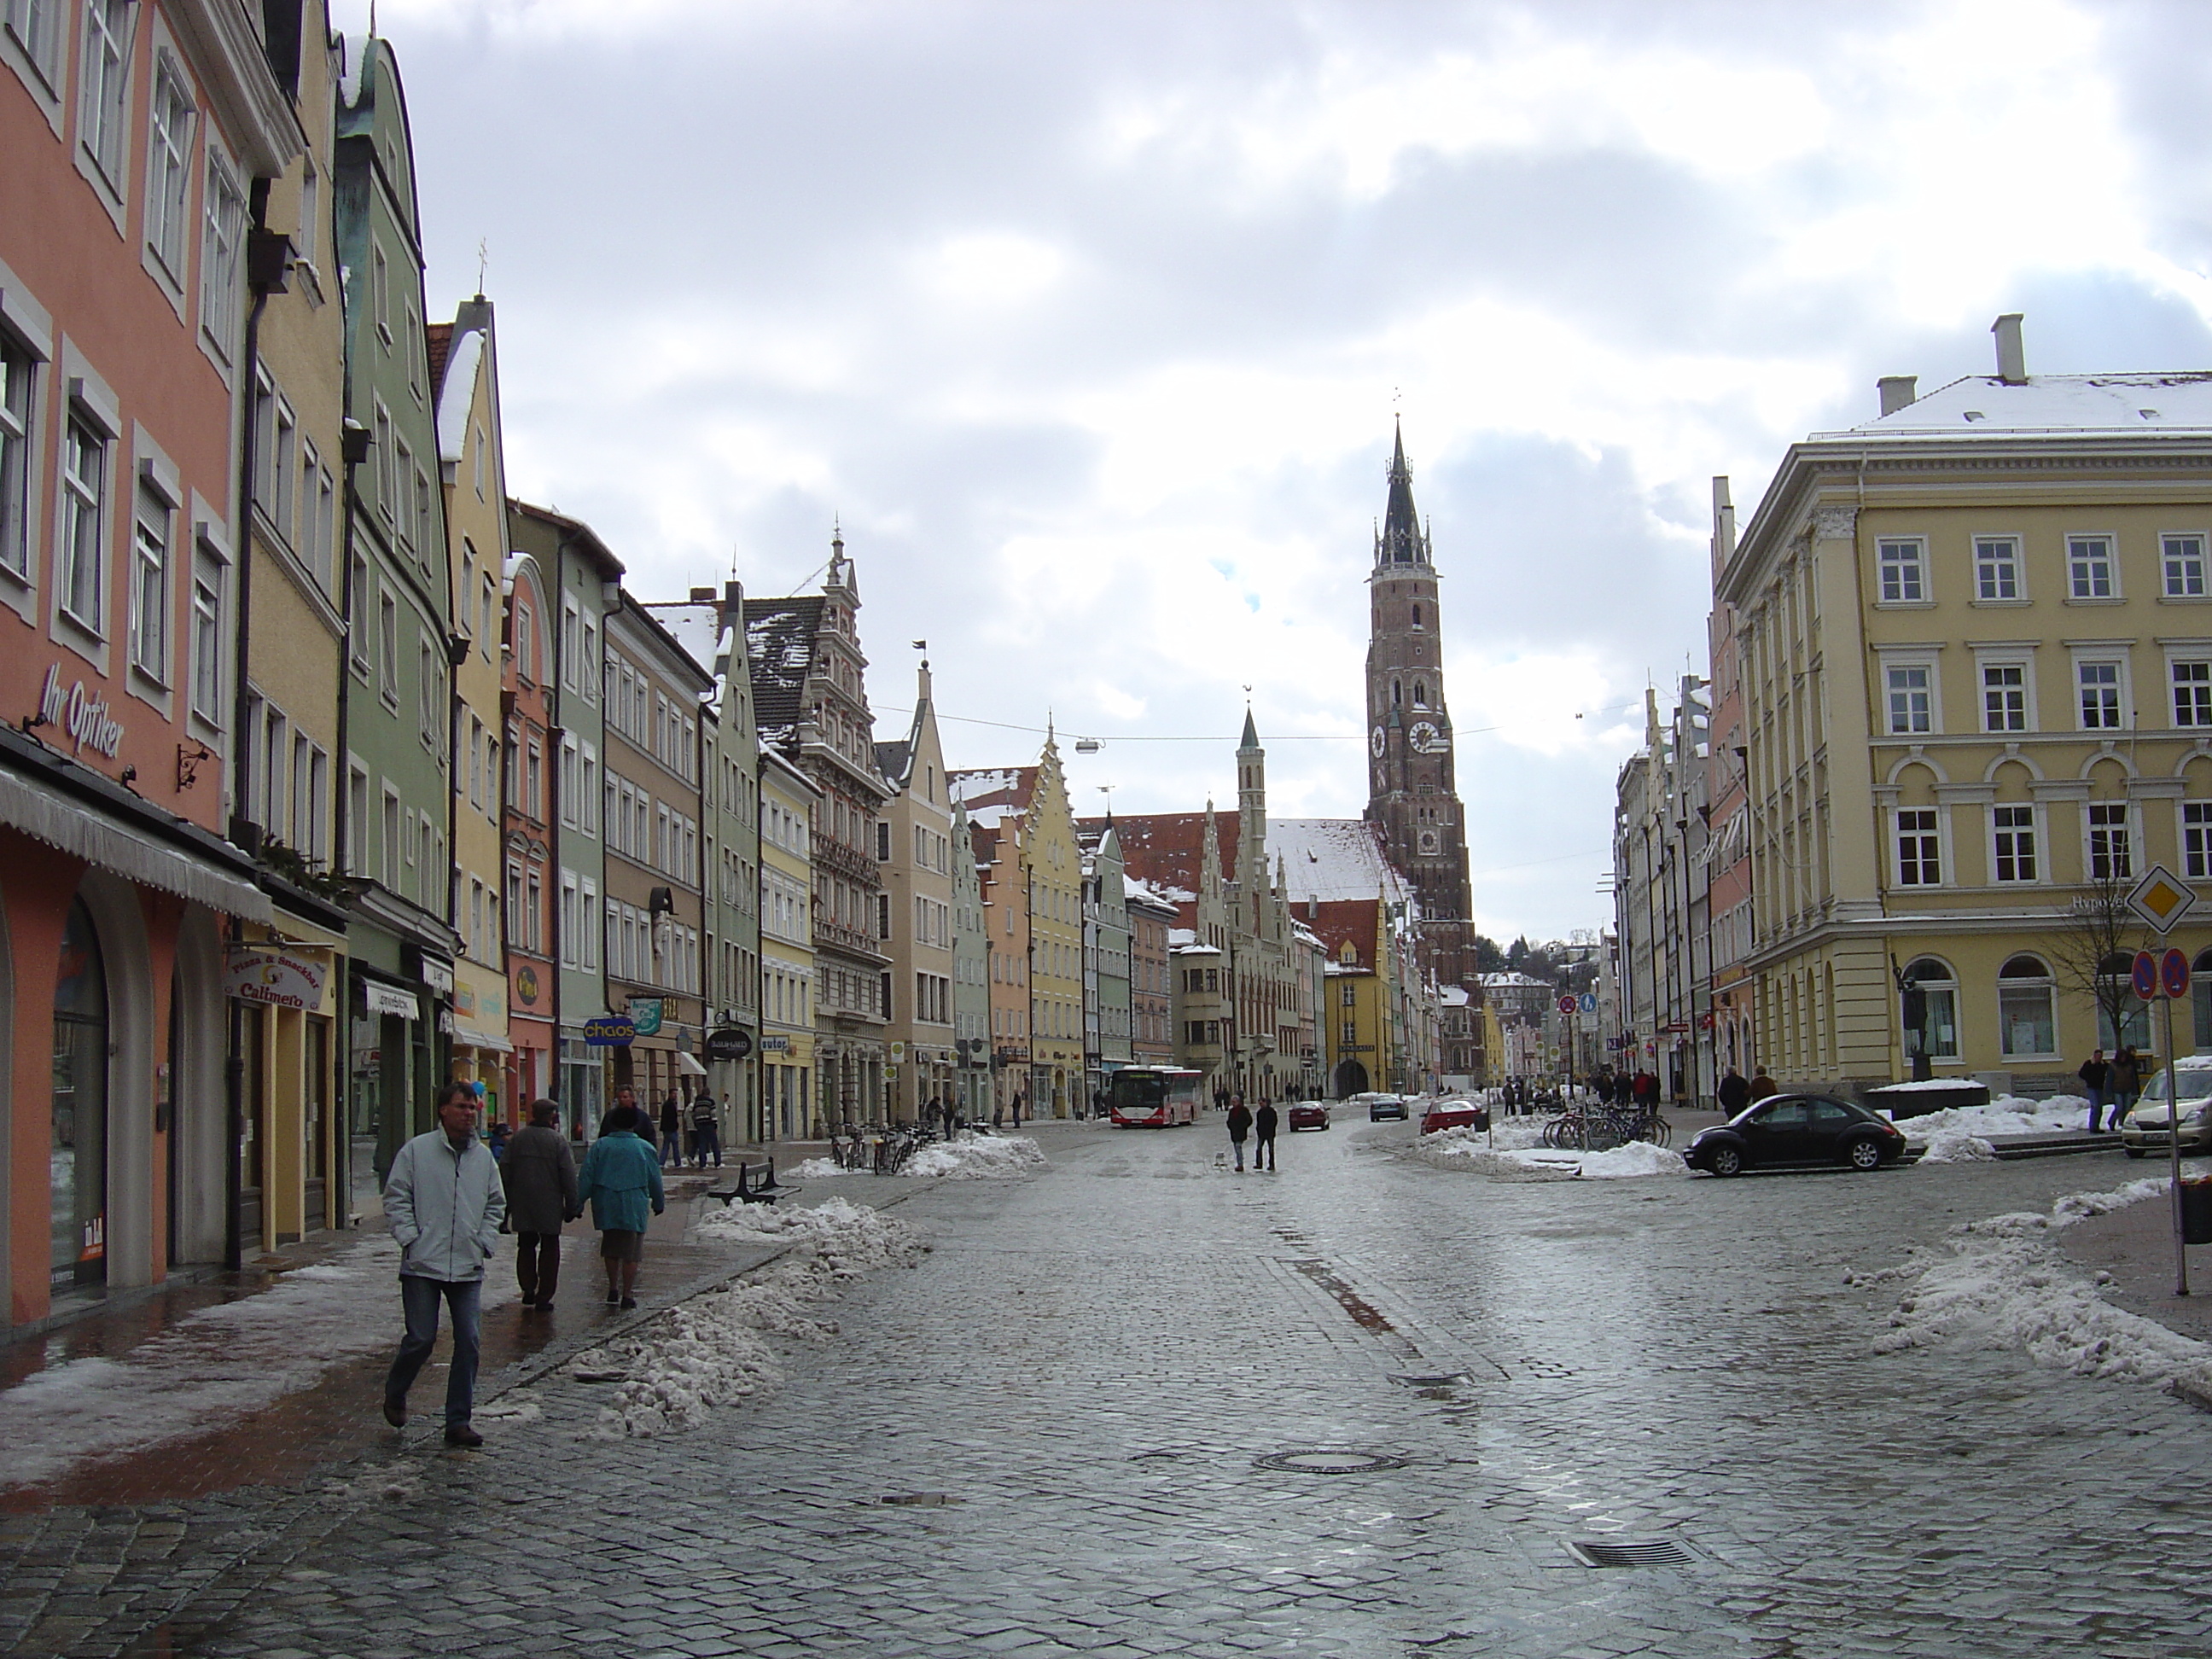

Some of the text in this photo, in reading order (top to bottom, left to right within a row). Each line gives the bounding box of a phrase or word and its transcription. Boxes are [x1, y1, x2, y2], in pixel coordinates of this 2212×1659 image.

[40, 661, 125, 759] Ihr Optiker
[231, 958, 261, 975] Pizza
[265, 955, 275, 963] &
[278, 956, 320, 989] Snackbar
[240, 982, 304, 1007] Calimero
[584, 1022, 635, 1038] chaos
